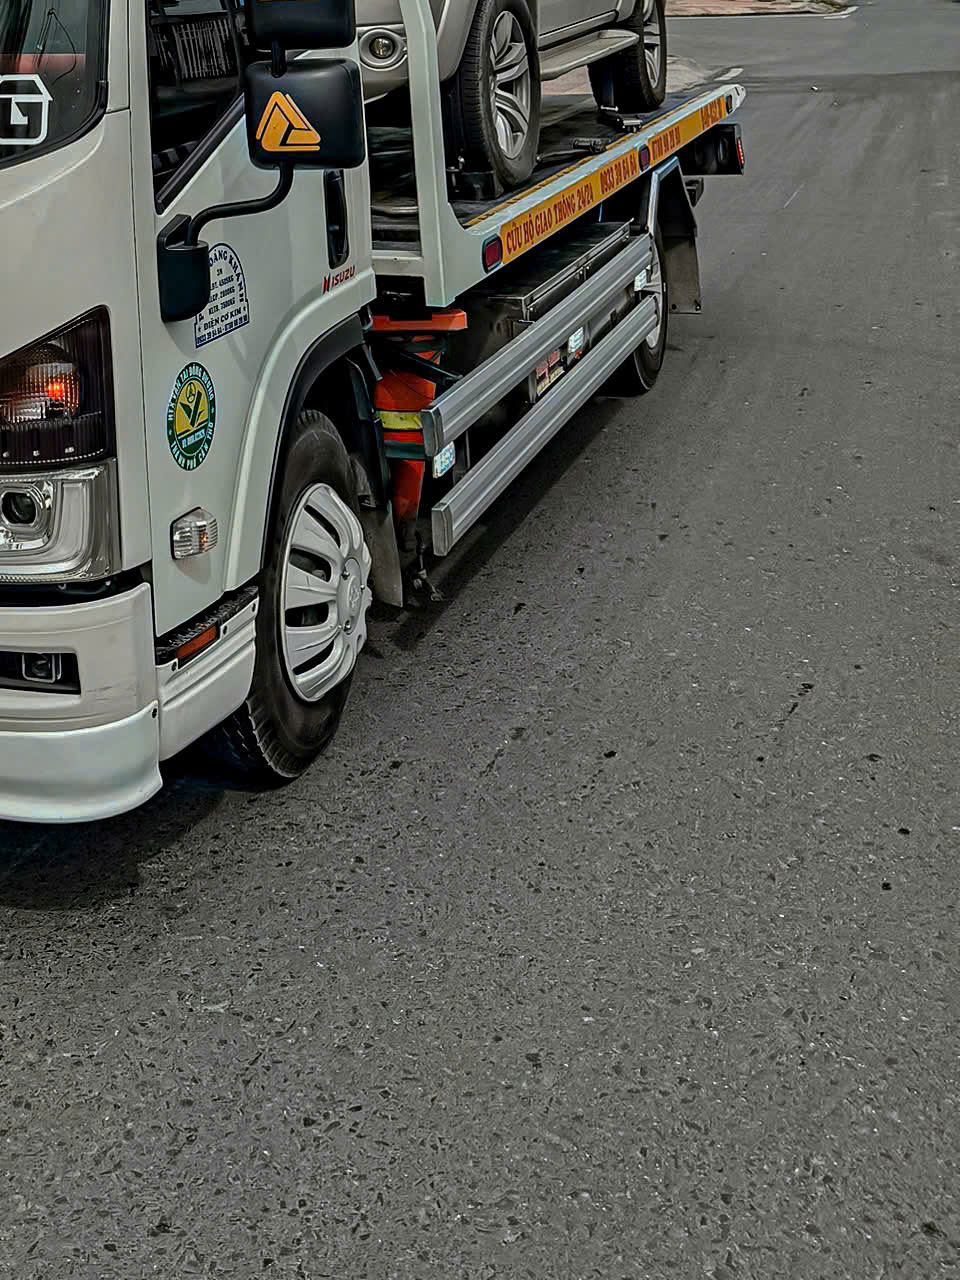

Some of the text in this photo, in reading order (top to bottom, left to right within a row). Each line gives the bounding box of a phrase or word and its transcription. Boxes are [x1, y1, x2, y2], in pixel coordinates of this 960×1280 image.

[534, 208, 553, 235] GIAO
[332, 265, 356, 287] ISUZU
[229, 306, 242, 320] KIM
